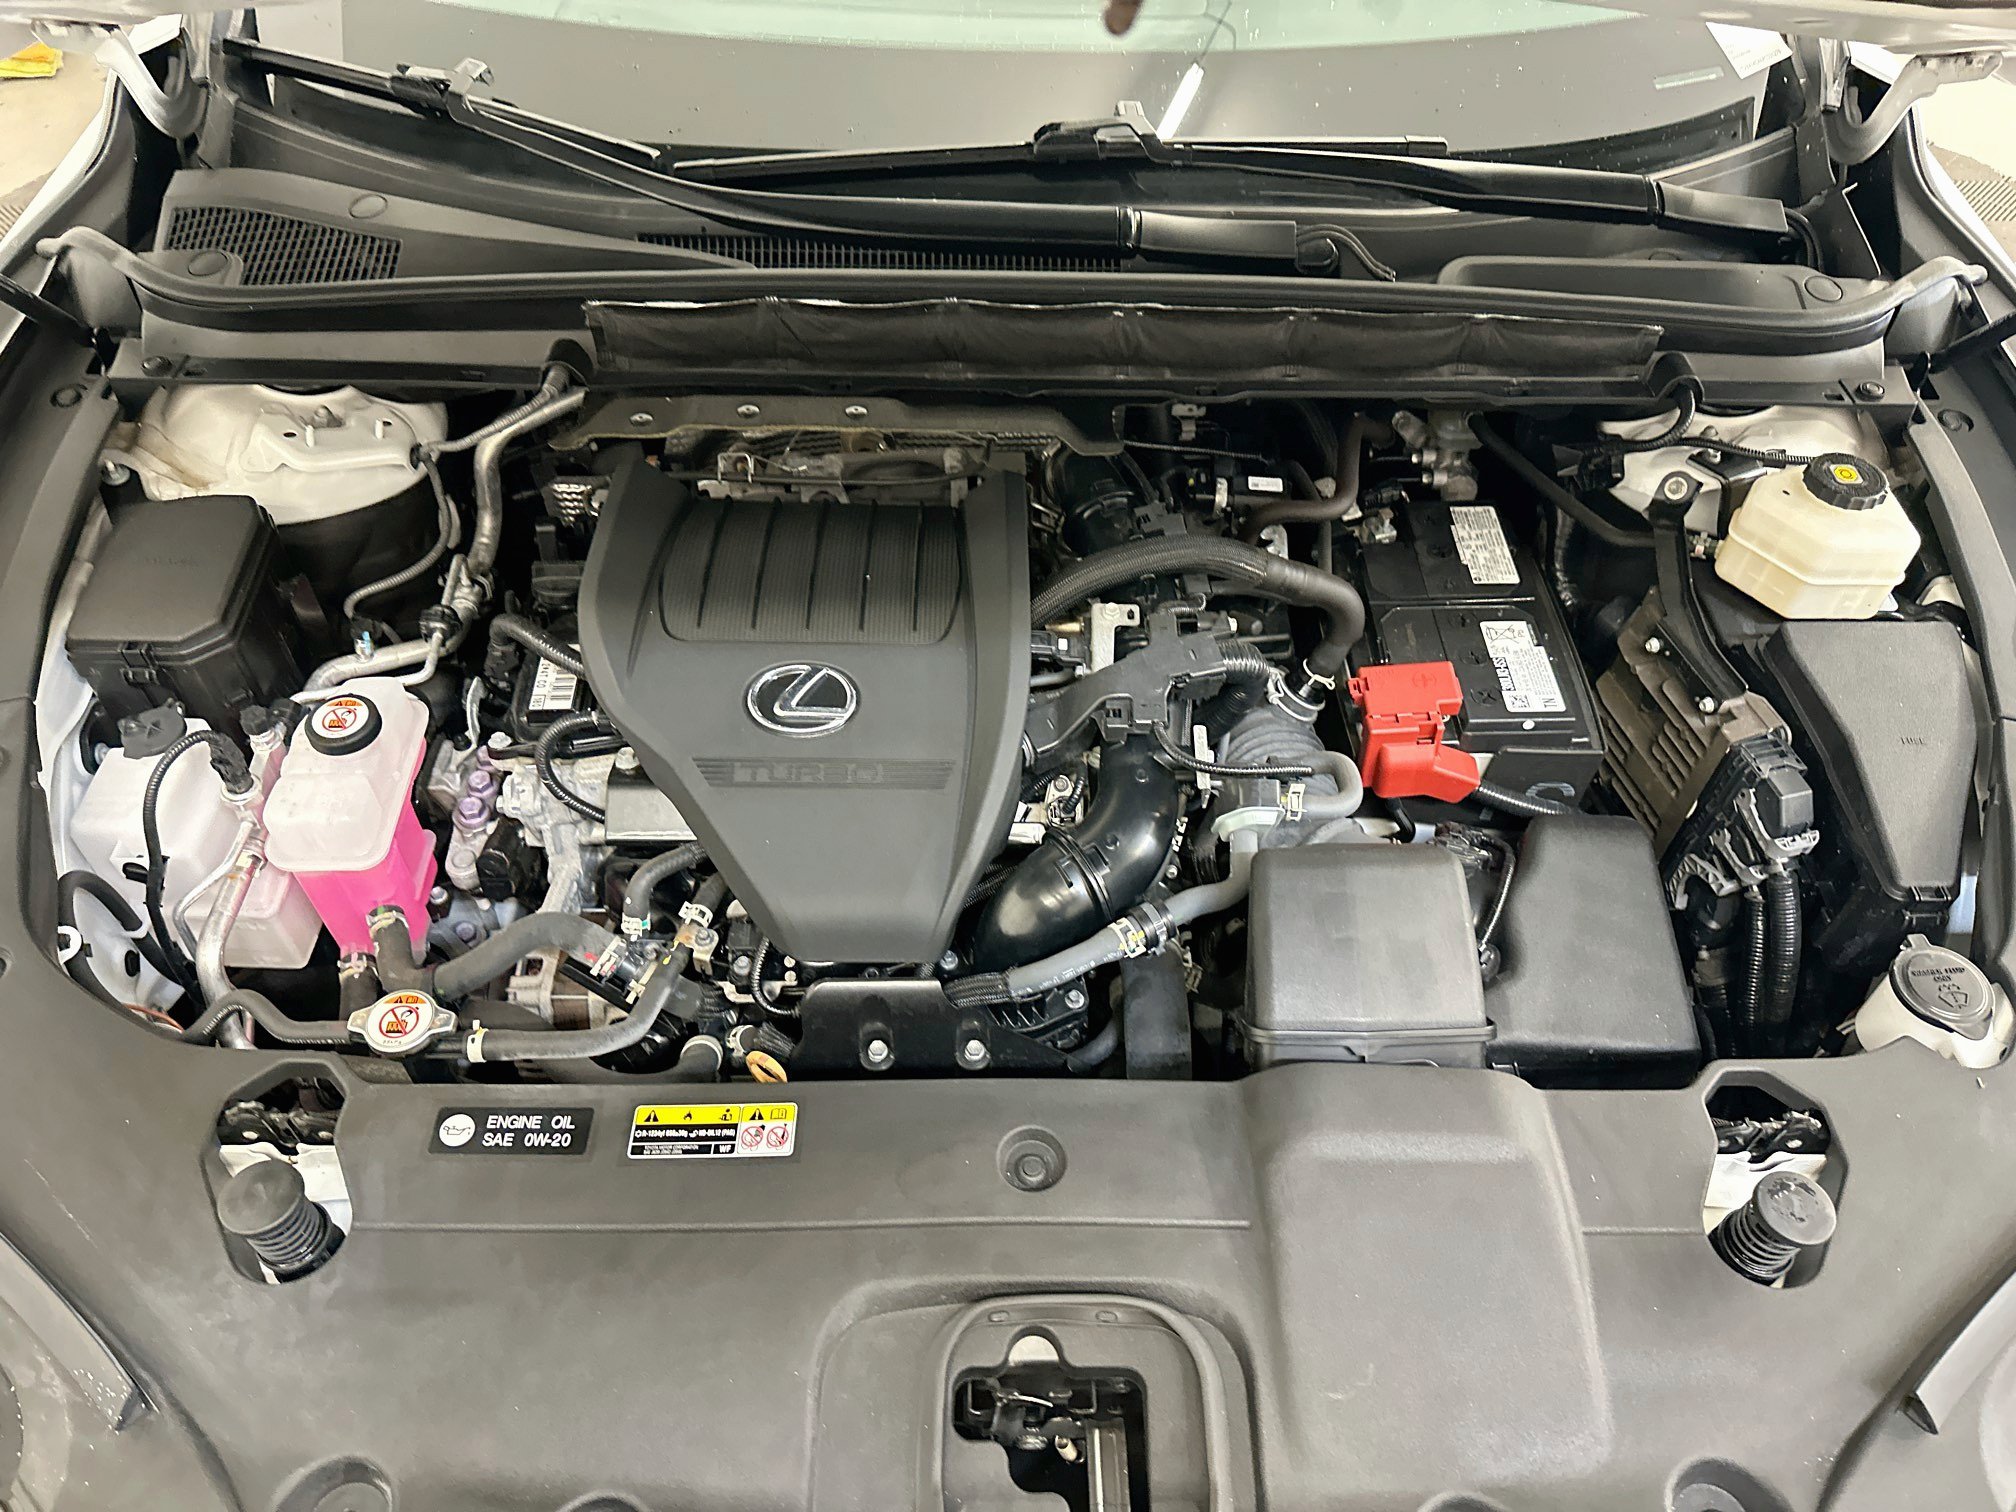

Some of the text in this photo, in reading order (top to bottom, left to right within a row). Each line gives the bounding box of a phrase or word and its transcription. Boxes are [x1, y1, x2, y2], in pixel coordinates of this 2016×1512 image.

[486, 1115, 575, 1129] ENGINE OIL
[481, 1132, 572, 1147] SAE 0W-20
